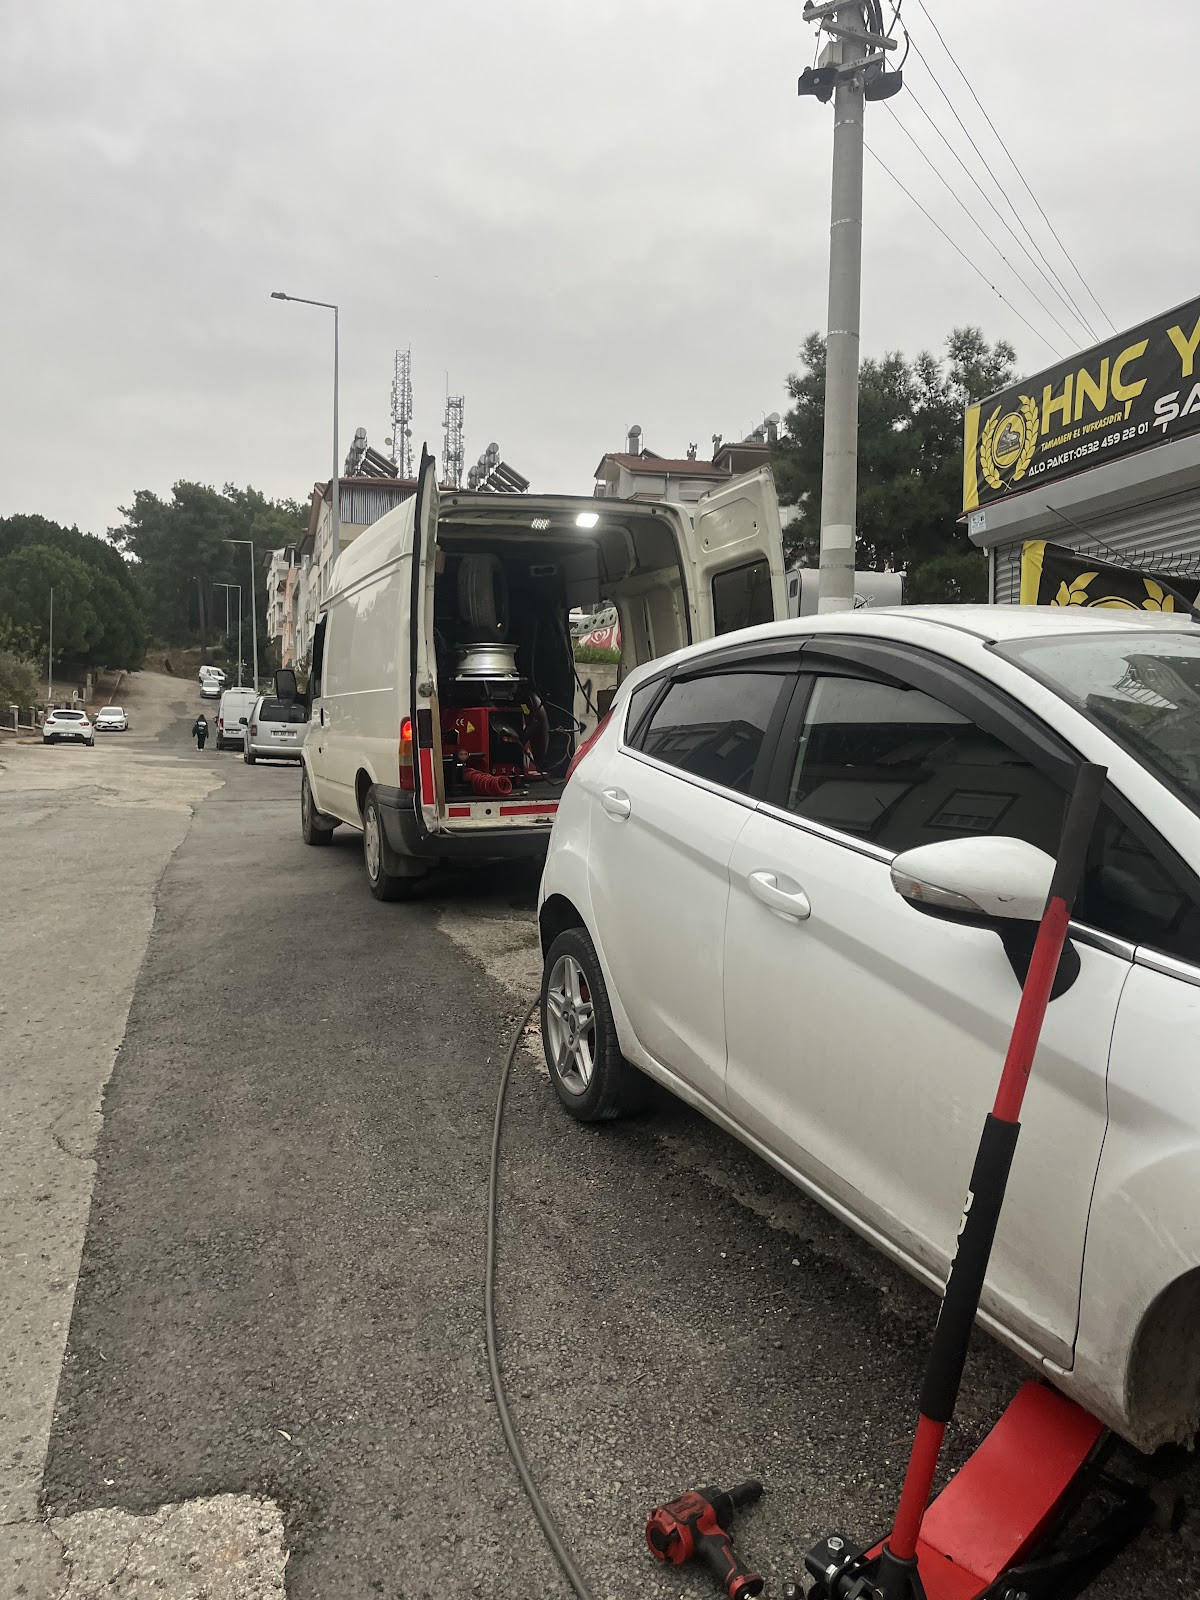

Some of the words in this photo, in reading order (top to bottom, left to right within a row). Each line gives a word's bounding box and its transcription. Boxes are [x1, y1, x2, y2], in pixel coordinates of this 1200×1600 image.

[1041, 338, 1149, 435] HNÇ
[1166, 316, 1200, 378] Y
[1028, 462, 1046, 476] ALO
[1101, 432, 1120, 448] 459
[1122, 426, 1136, 441] 22
[1138, 421, 1149, 434] 01
[1073, 428, 1081, 439] EL
